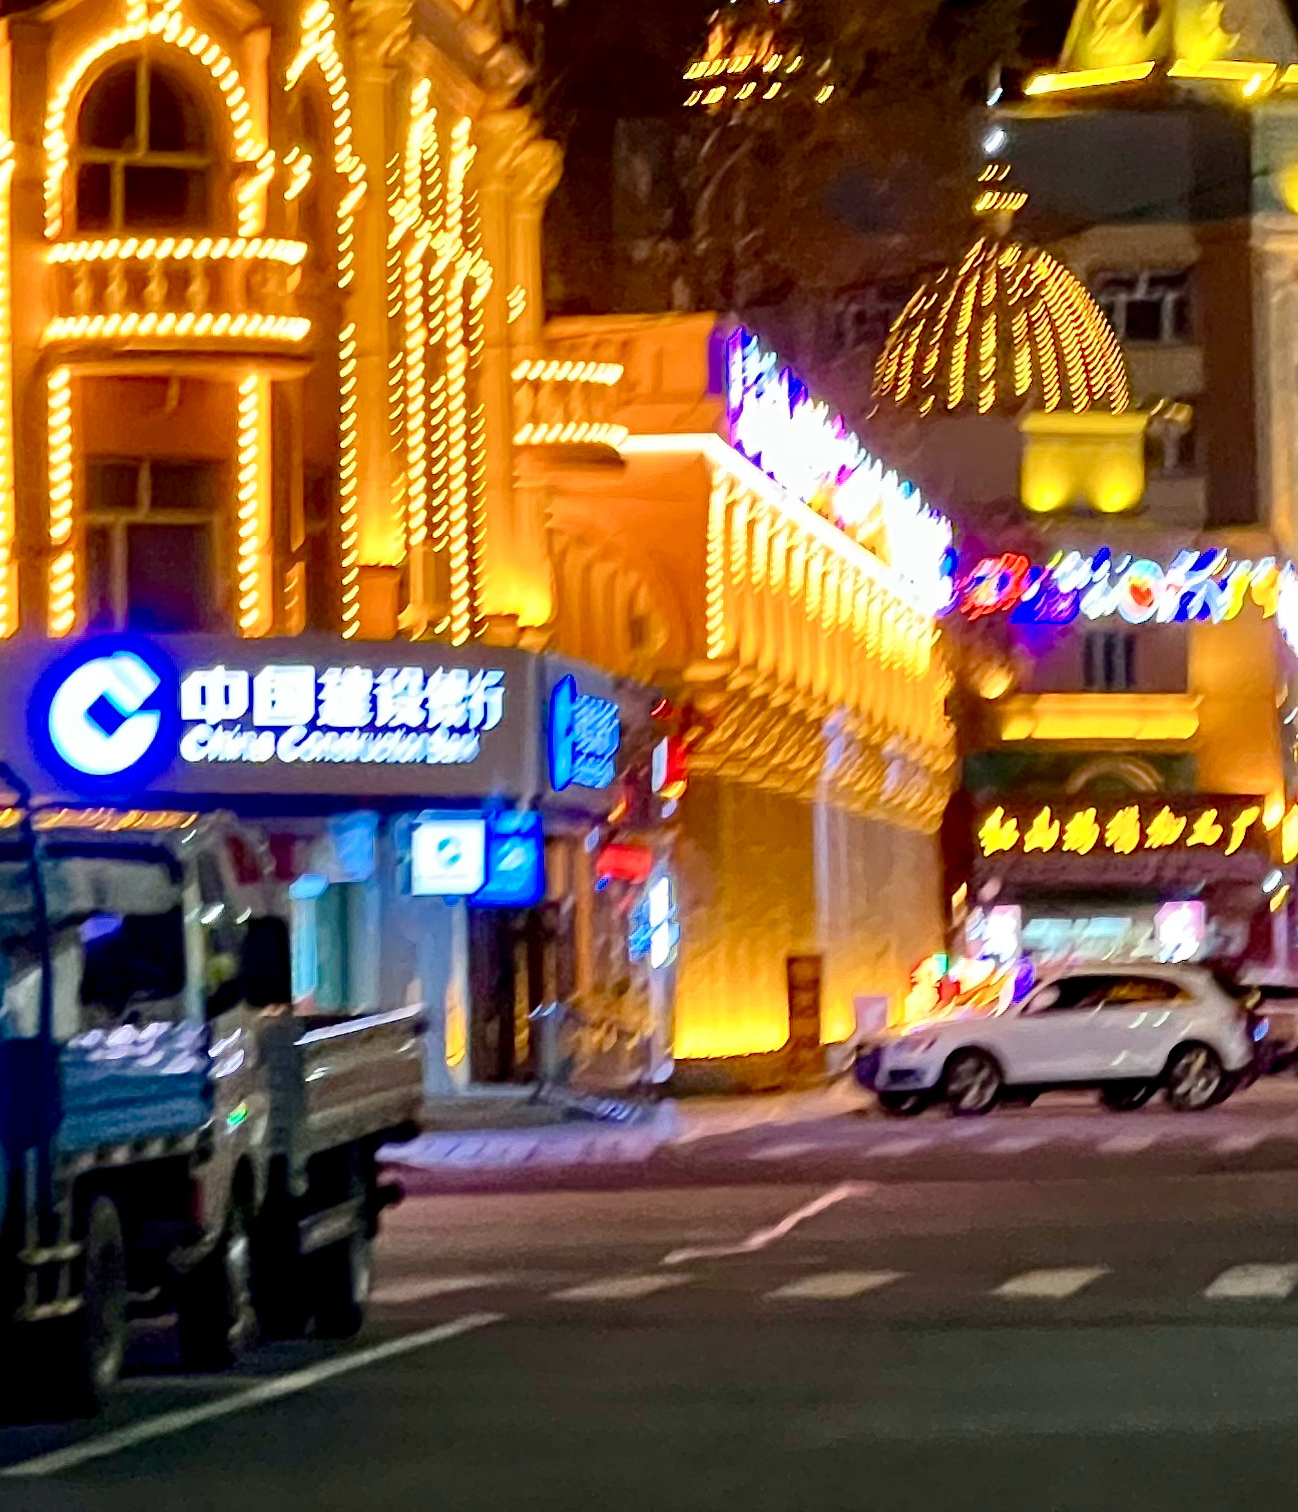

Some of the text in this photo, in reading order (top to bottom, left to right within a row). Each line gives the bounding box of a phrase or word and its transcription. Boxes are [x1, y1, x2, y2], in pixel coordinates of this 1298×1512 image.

[180, 664, 505, 731] 中国建设银行
[180, 723, 275, 763] China
